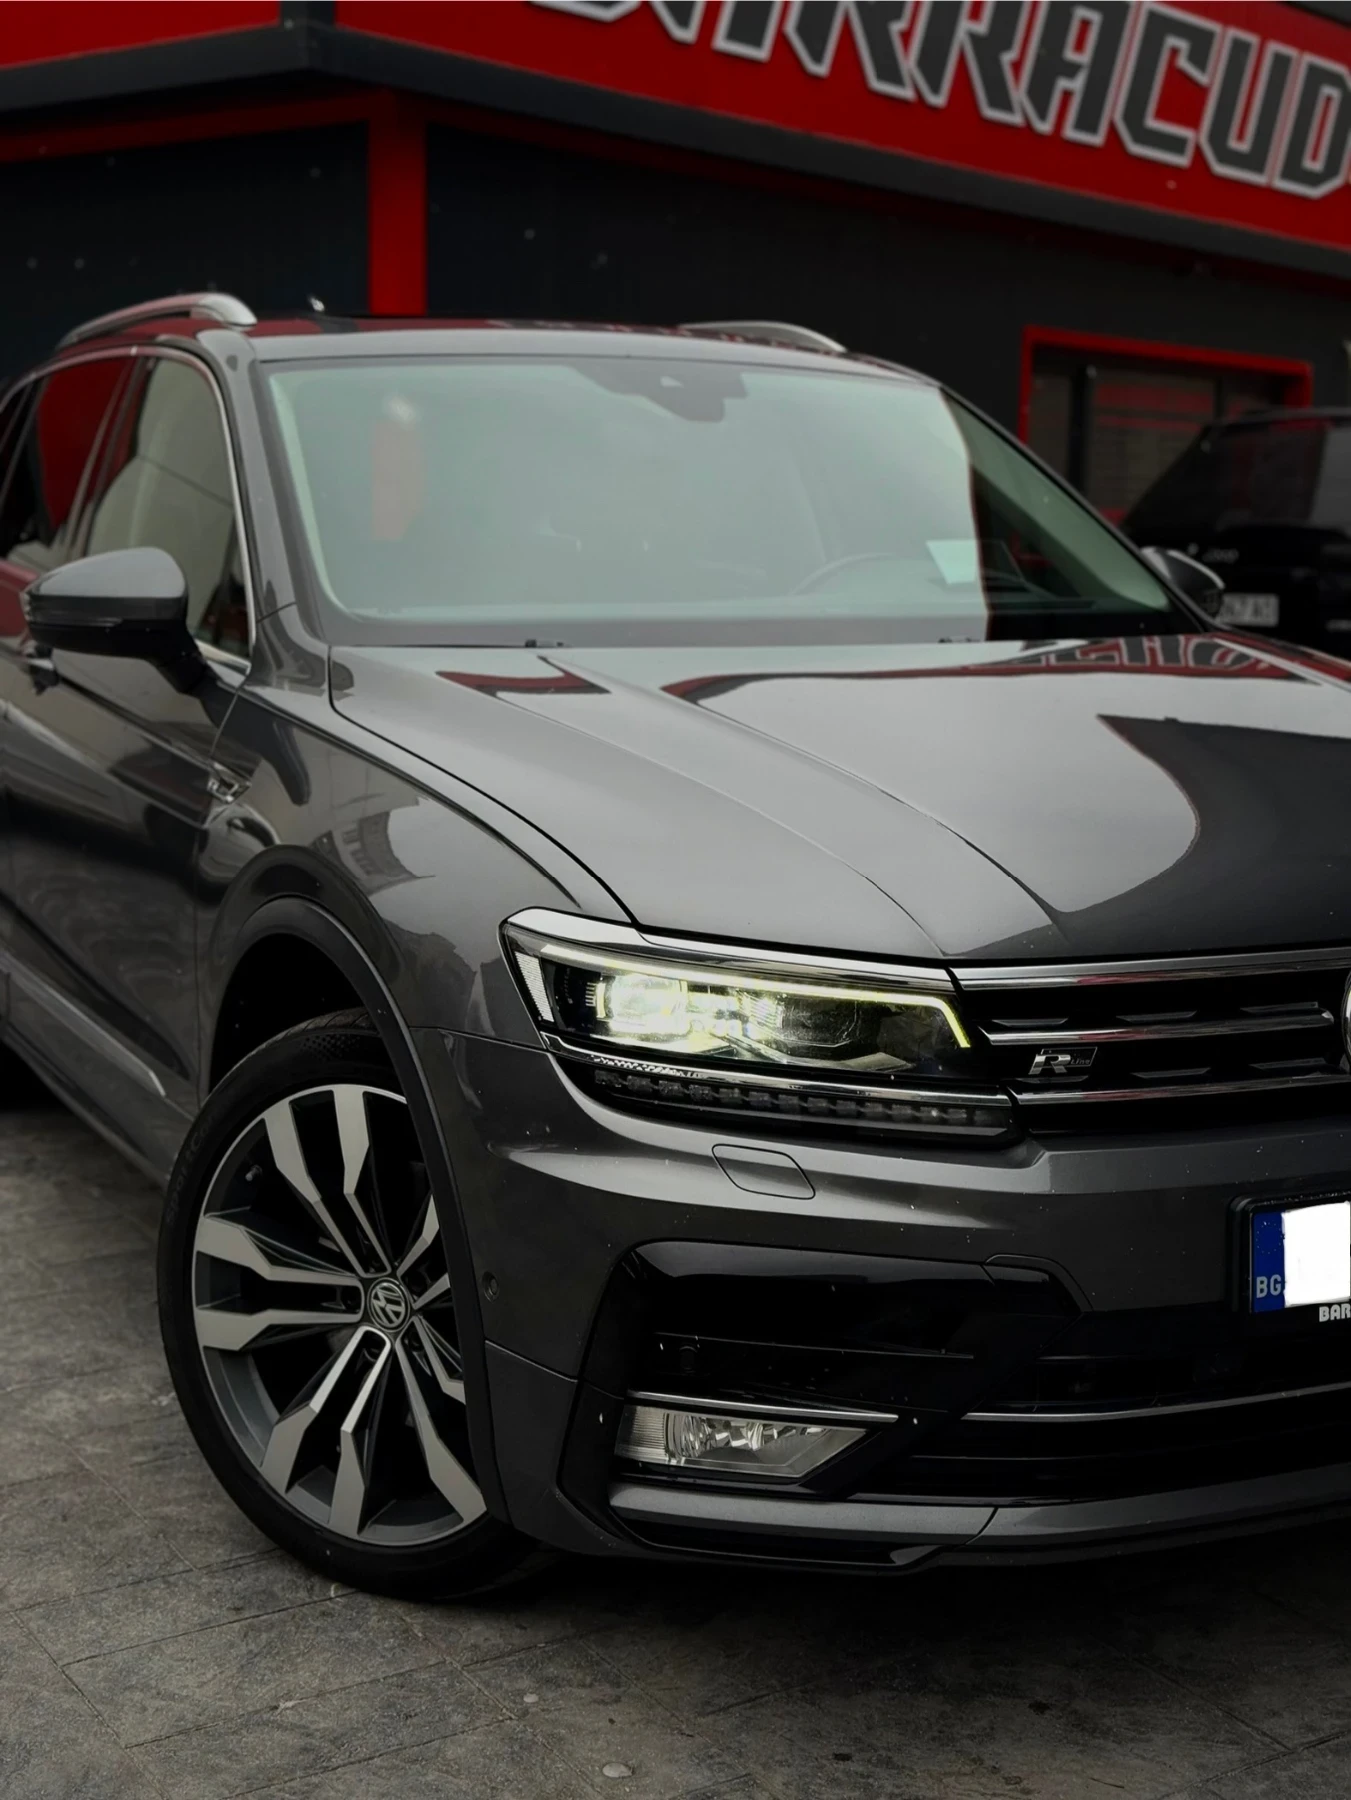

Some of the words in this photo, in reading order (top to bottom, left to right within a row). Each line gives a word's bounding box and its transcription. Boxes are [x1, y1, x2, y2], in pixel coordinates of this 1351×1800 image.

[530, 0, 1351, 199] RRACUD
[1256, 1274, 1282, 1298] BG
[1319, 1303, 1351, 1322] BAR
